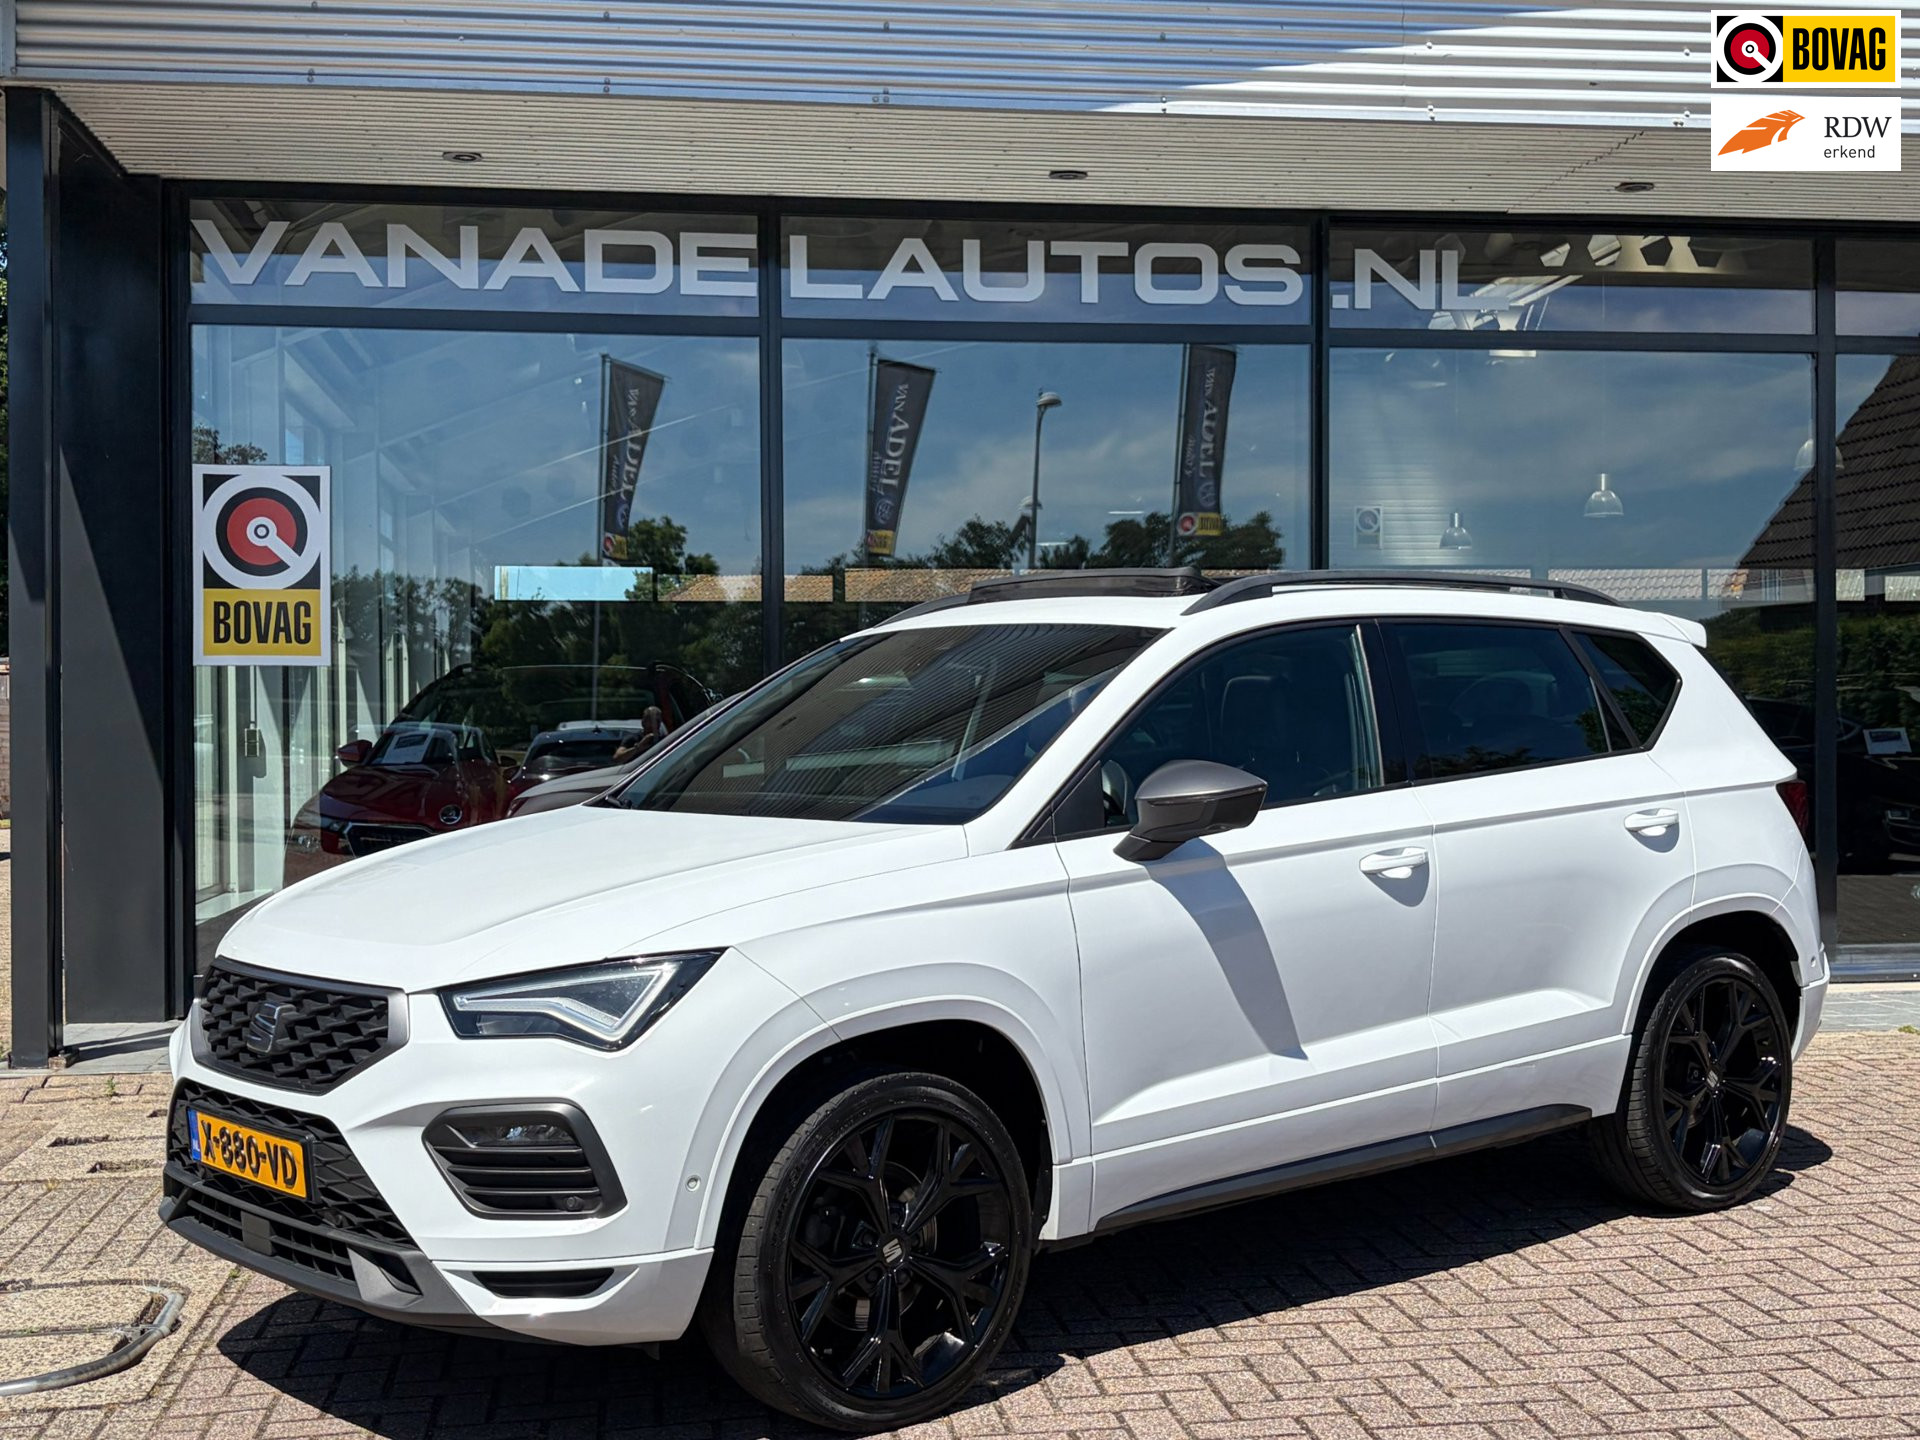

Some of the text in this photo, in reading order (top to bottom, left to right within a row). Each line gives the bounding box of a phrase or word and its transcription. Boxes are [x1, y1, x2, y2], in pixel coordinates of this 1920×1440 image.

[878, 383, 910, 495] VAN ADEL
[1199, 400, 1218, 478] ADEL
[213, 600, 312, 645] BOVAG
[201, 1119, 298, 1189] X-880-VD
